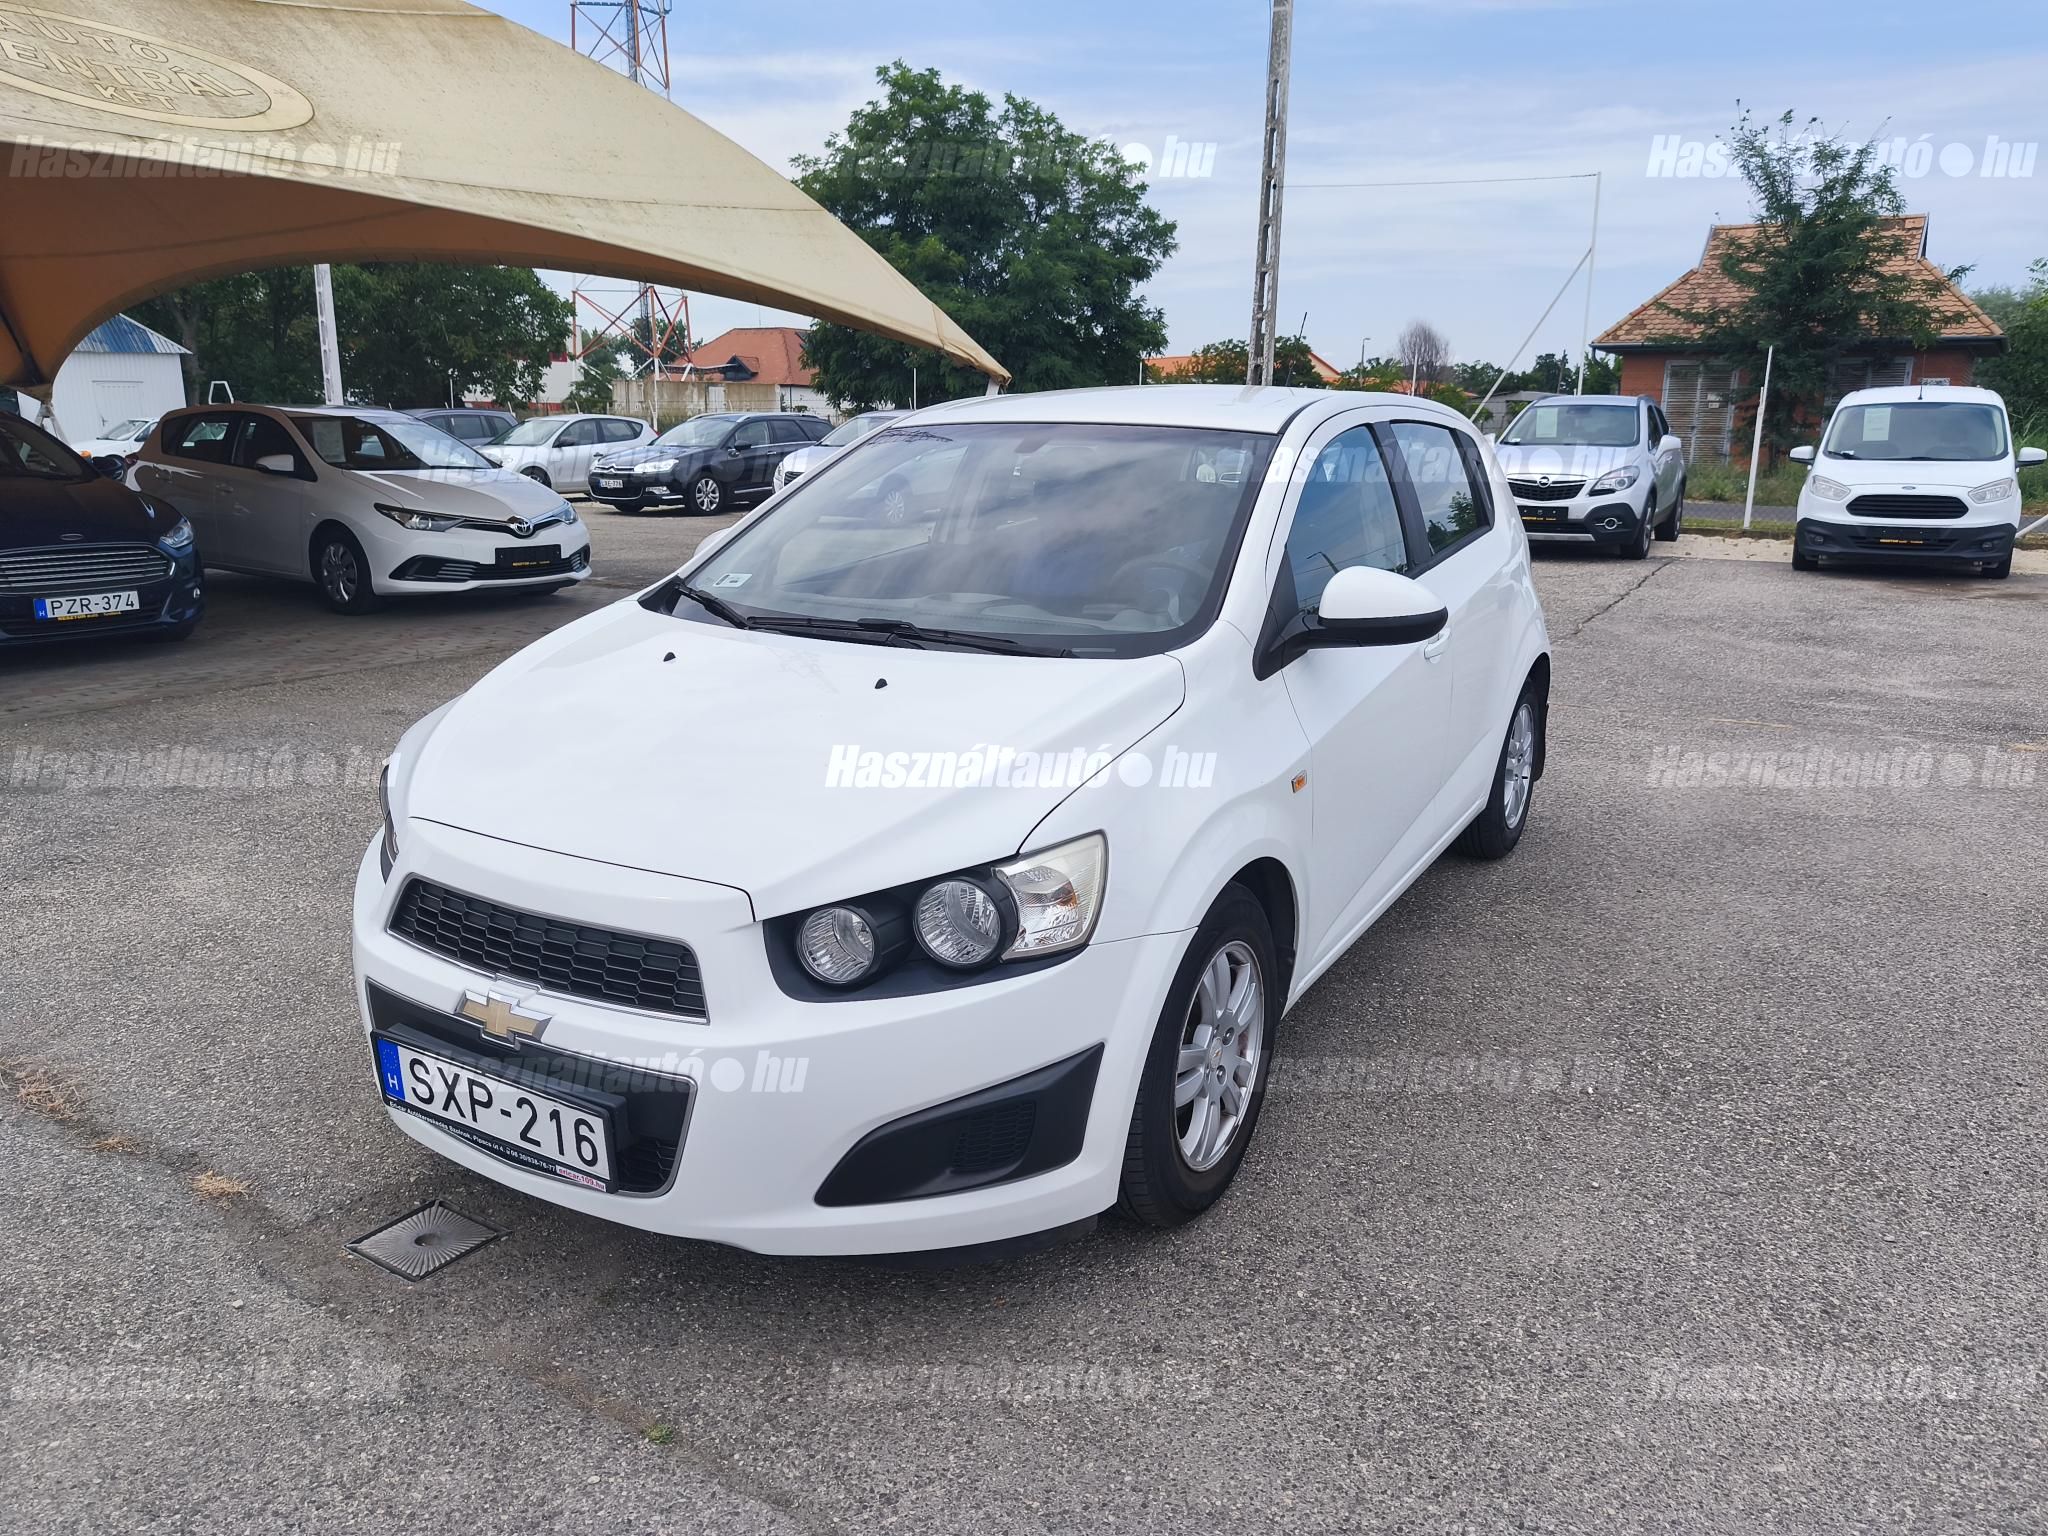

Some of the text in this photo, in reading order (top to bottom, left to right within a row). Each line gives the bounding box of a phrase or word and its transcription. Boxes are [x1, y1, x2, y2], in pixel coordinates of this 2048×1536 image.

[91, 82, 177, 111] KFT
[50, 593, 136, 616] PZR-374
[388, 1057, 599, 1168] H SXP-216
